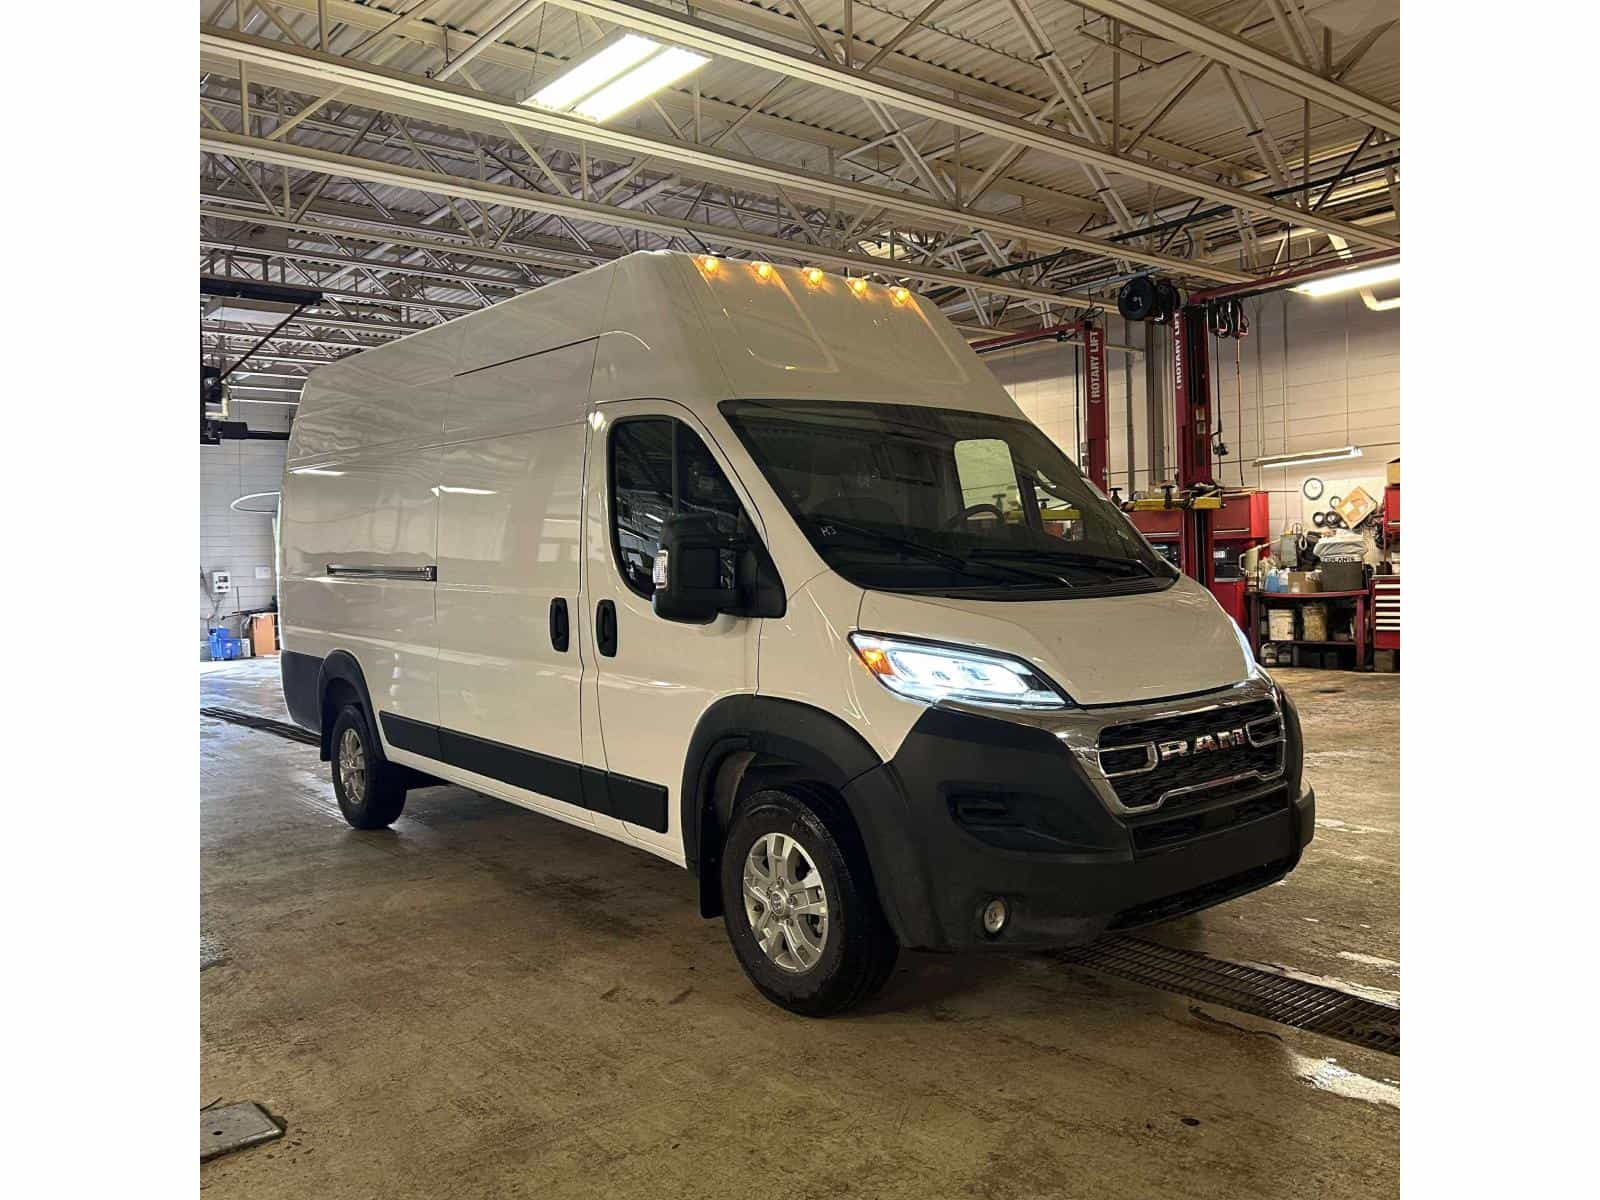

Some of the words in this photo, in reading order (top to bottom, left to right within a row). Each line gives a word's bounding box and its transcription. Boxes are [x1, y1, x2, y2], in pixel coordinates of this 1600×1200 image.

[1089, 331, 1099, 353] LIFT
[1090, 356, 1101, 398] ROTARY
[1158, 728, 1246, 761] RAM
